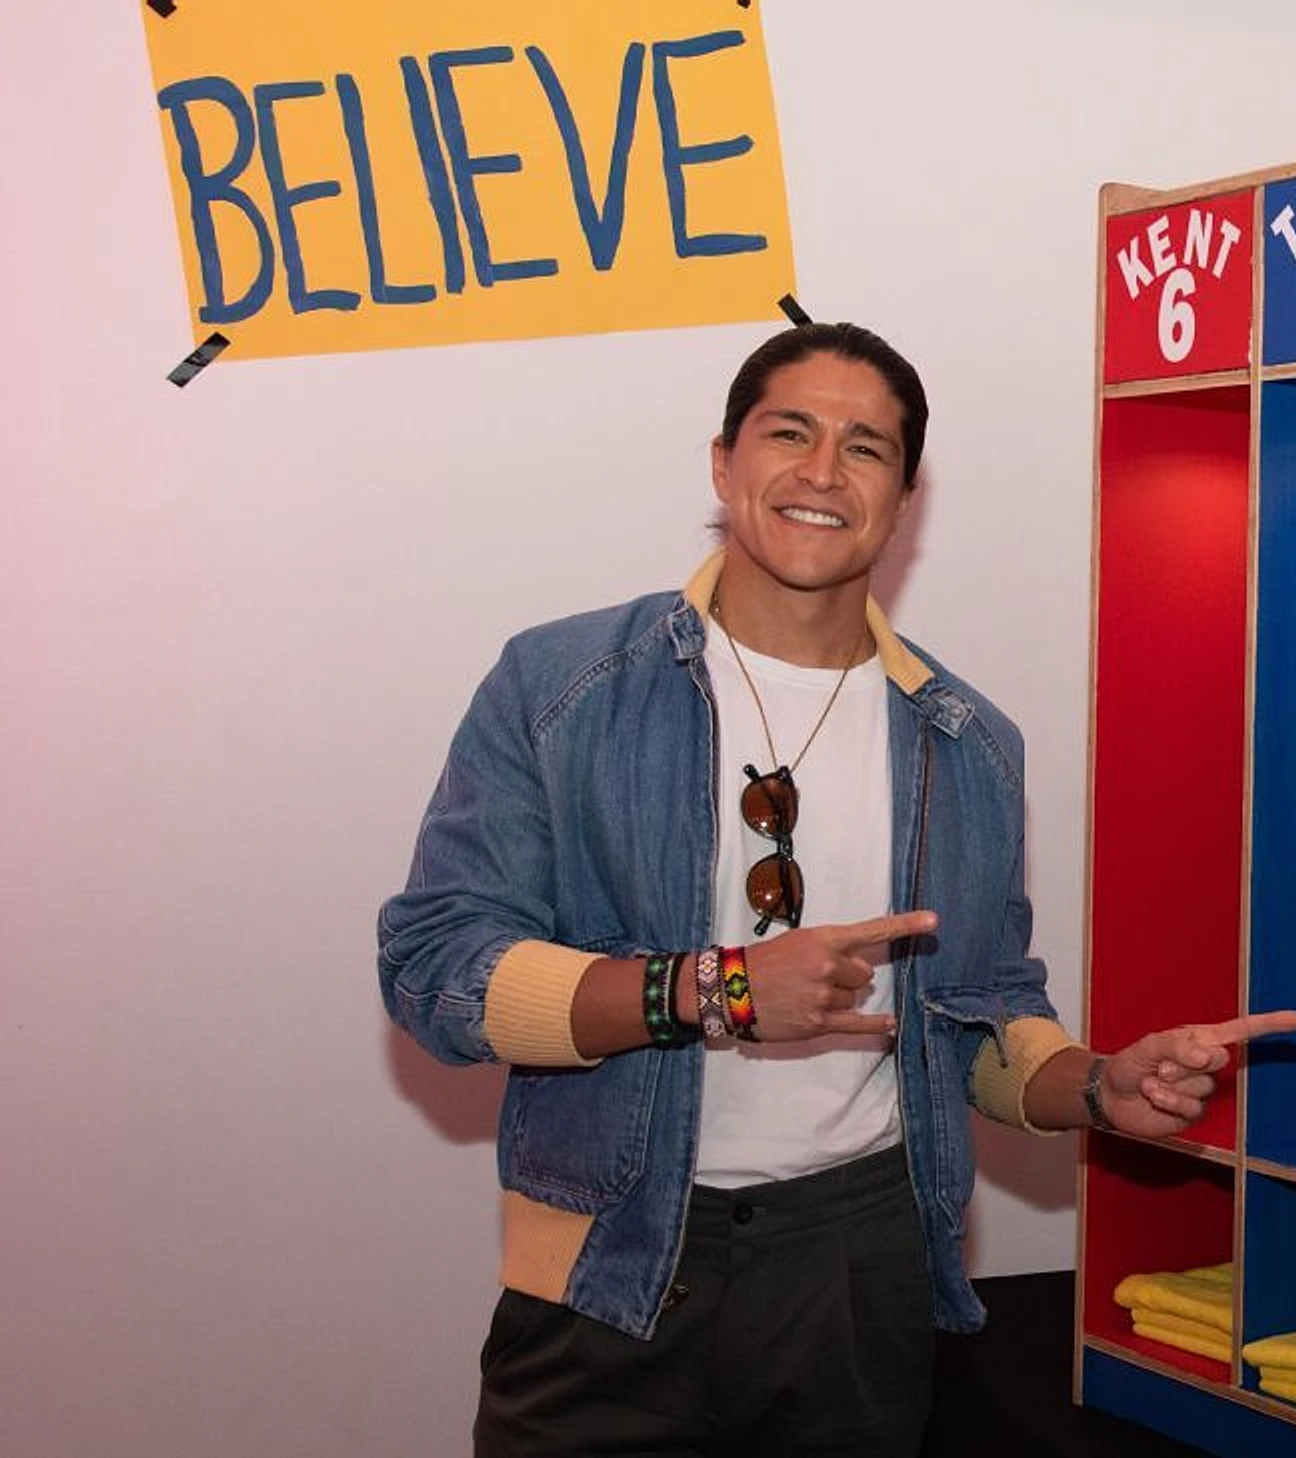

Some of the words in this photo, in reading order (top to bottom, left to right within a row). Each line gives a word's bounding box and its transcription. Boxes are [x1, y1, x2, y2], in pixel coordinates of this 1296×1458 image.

[157, 30, 767, 323] BELIEVE
[1117, 209, 1241, 299] KENT
[1158, 268, 1195, 363] 6
